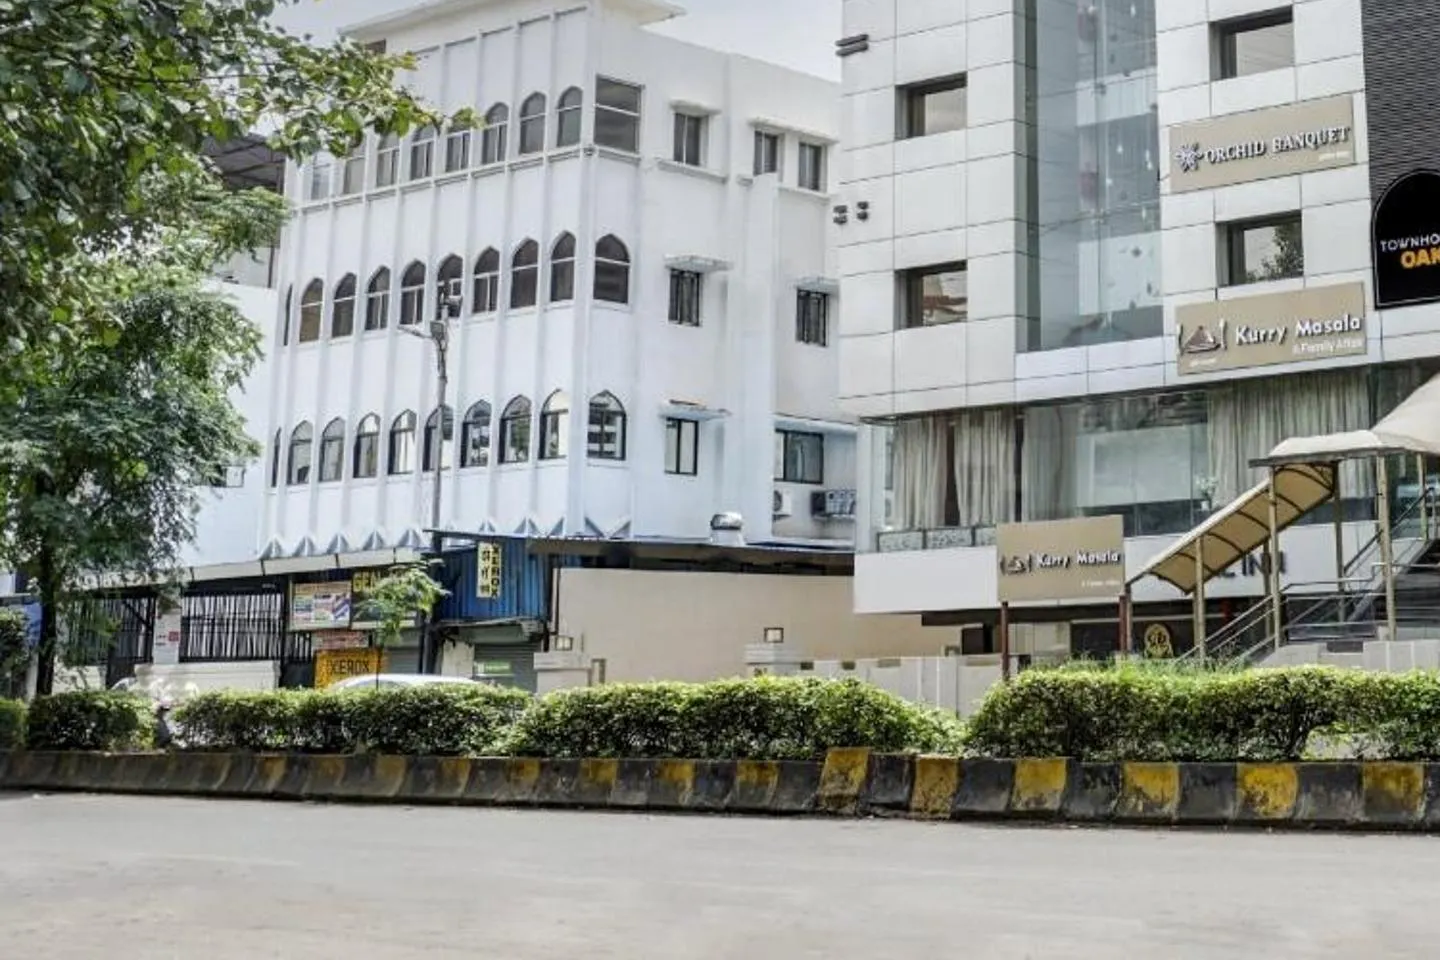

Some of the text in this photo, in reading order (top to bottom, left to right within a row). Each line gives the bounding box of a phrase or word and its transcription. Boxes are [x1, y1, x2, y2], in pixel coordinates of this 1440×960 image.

[1205, 126, 1351, 164] ORCHID BANQUET
[1235, 312, 1362, 346] Kurry Masala
[1038, 549, 1121, 569] Kurry Masala
